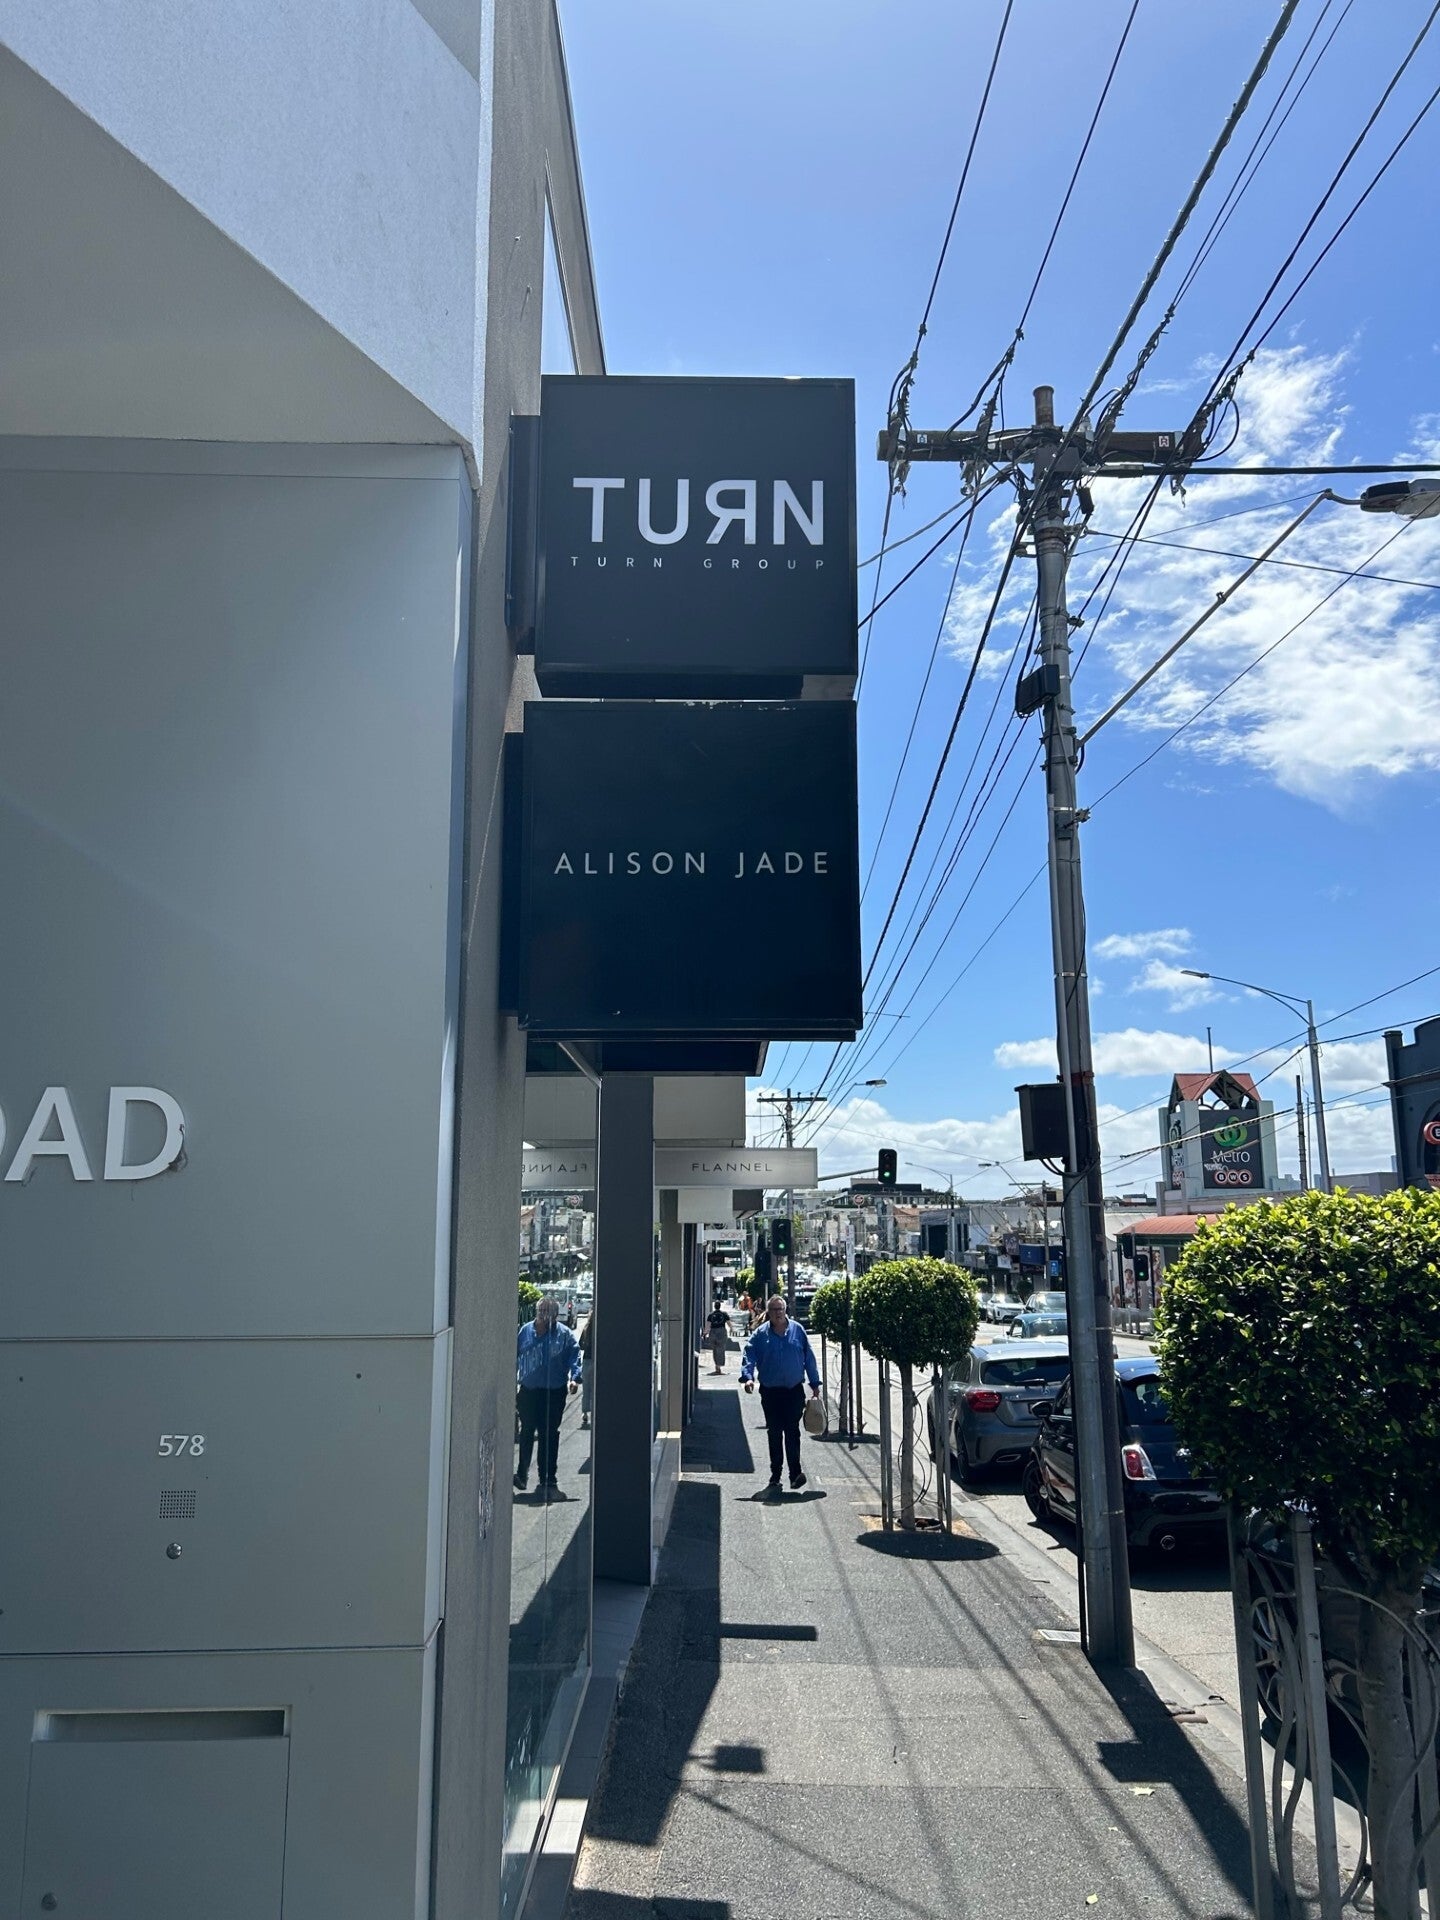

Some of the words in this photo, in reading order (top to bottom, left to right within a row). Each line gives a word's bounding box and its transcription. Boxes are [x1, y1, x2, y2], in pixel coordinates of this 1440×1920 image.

[571, 556, 662, 568] TURN
[703, 558, 824, 570] GROUP
[554, 852, 705, 874] ALISON
[735, 851, 828, 878] JADE
[0, 1086, 186, 1181] AD
[1212, 1150, 1250, 1163] Metro
[691, 1163, 773, 1172] FLANNEL
[158, 1434, 205, 1456] 578
